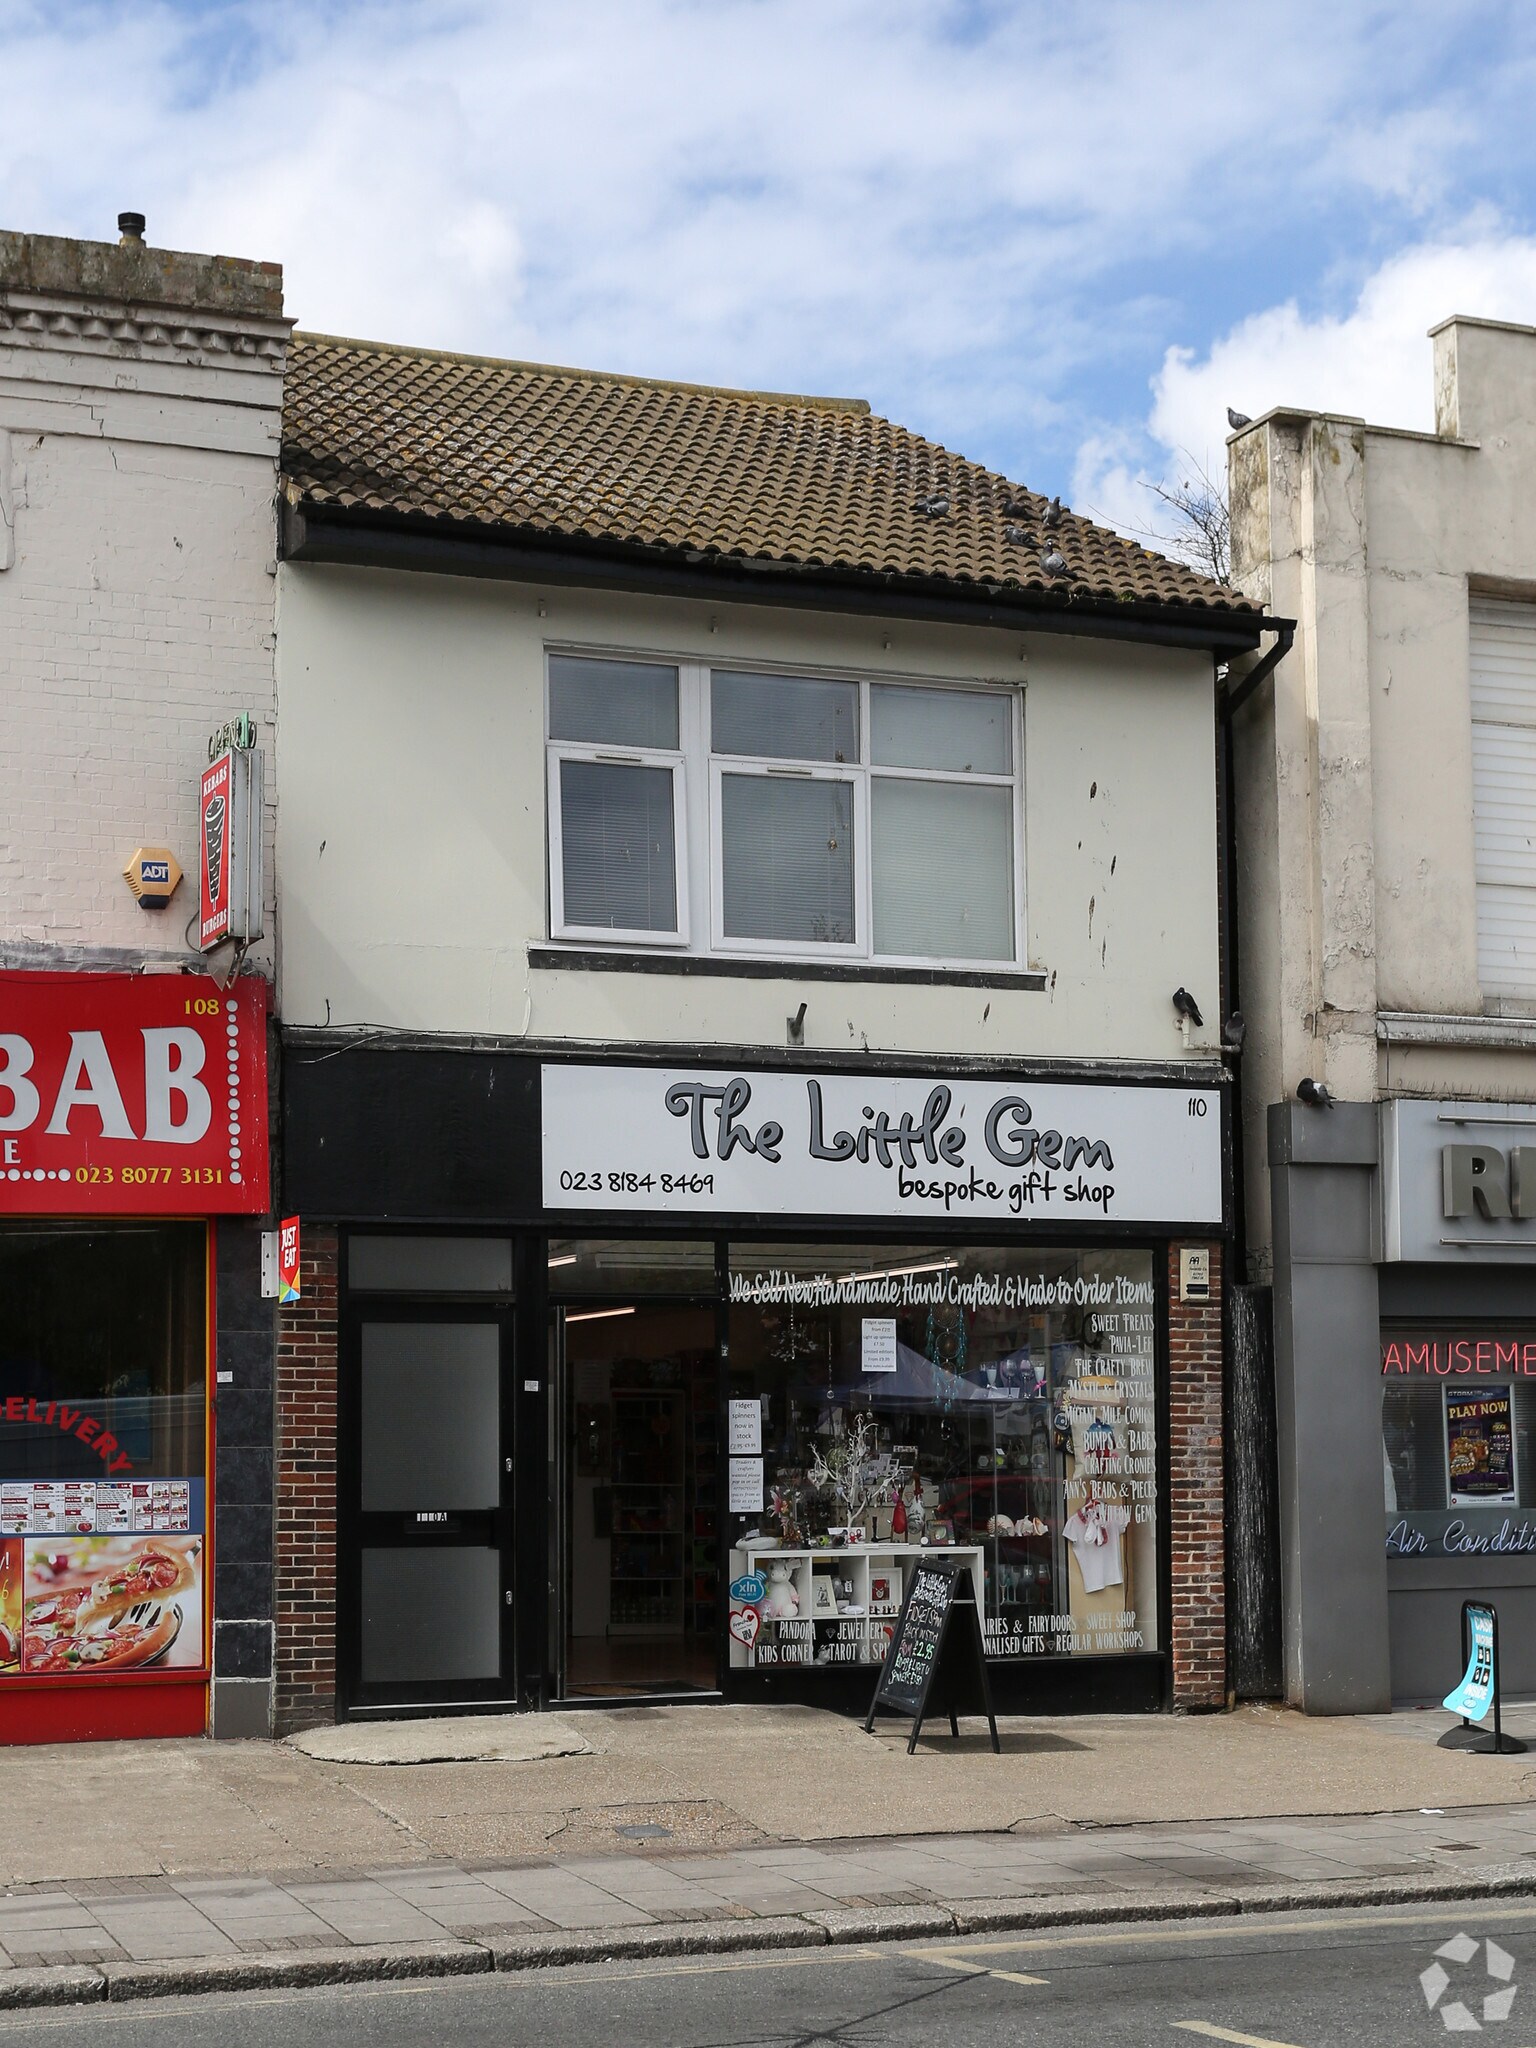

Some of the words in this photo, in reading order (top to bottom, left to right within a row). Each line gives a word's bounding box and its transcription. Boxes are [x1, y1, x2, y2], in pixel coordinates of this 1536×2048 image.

[203, 765, 227, 797] KEBABS
[142, 866, 168, 878] ADT
[202, 908, 227, 937] BURGERS
[185, 999, 220, 1015] 108
[1188, 1098, 1207, 1116] 110
[665, 1078, 784, 1163] The
[807, 1079, 966, 1169] Little
[984, 1096, 1114, 1171] Gem
[75, 1167, 114, 1184] 023
[121, 1167, 172, 1184] 8077
[181, 1167, 222, 1184] 3131
[560, 1170, 602, 1191] 023
[608, 1171, 656, 1193] 8184
[661, 1174, 714, 1194] 8469
[899, 1165, 1003, 1211] bespoke
[1008, 1171, 1057, 1213] gift
[1064, 1176, 1115, 1213] shop
[281, 1226, 296, 1252] JUST
[284, 1247, 296, 1269] EAT
[728, 1271, 753, 1303] We
[754, 1270, 783, 1304] Sell
[784, 1271, 815, 1308] New,
[814, 1272, 901, 1307] Handmade,
[902, 1272, 947, 1306] Hand
[948, 1272, 1003, 1312] Crafted
[1005, 1277, 1017, 1309] &
[1017, 1274, 1058, 1308] Made
[1056, 1276, 1073, 1304] to
[1074, 1273, 1114, 1305] Order
[1115, 1275, 1154, 1306] Items
[1091, 1313, 1119, 1333] SWEET
[1122, 1313, 1154, 1332] TREATS
[1109, 1335, 1152, 1354] PAVIA-LEE
[1075, 1358, 1092, 1377] THE
[1096, 1356, 1125, 1376] CRAFTY
[1128, 1358, 1152, 1376] BREW
[1383, 1341, 1536, 1375] AMUSEME
[1068, 1379, 1099, 1398] MYSTIC
[1104, 1384, 1111, 1393] &
[1114, 1380, 1153, 1398] CRYSTALS
[1065, 1405, 1098, 1425] MUTANT
[1101, 1405, 1121, 1425] MILE
[1125, 1406, 1153, 1424] COMICS
[1449, 1405, 1477, 1419] PLAY
[1480, 1401, 1508, 1415] NOW
[0, 1397, 133, 1473] ELIVERY
[1083, 1431, 1113, 1452] BUMPS
[1116, 1435, 1127, 1450] &
[1128, 1430, 1156, 1452] BABES
[1085, 1454, 1121, 1474] CRAFTING
[1124, 1455, 1156, 1474] CRONIES
[1063, 1478, 1086, 1500] ANN'S
[1090, 1480, 1117, 1500] BEADS
[1119, 1482, 1129, 1497] &
[1130, 1480, 1157, 1500] PIECES
[1135, 1504, 1157, 1524] GEMS
[1385, 1519, 1427, 1553] Air
[1443, 1519, 1536, 1553] Conditi
[779, 1620, 817, 1640] PANDORA
[837, 1622, 885, 1640] JEWELERY
[1013, 1620, 1023, 1634] &
[1028, 1615, 1049, 1633] FAIRY
[1051, 1613, 1076, 1632] DOORS
[1087, 1611, 1112, 1630] SWEET
[1116, 1610, 1136, 1628] SHOP
[758, 1645, 778, 1663] KIDS
[781, 1644, 814, 1662] CORNER
[830, 1643, 857, 1660] TAROT
[860, 1645, 870, 1660] &
[872, 1643, 890, 1660] SPI
[1022, 1635, 1045, 1653] GIFTS
[1056, 1633, 1092, 1652] REGULAR
[1096, 1631, 1144, 1649] WORKSHOPS
